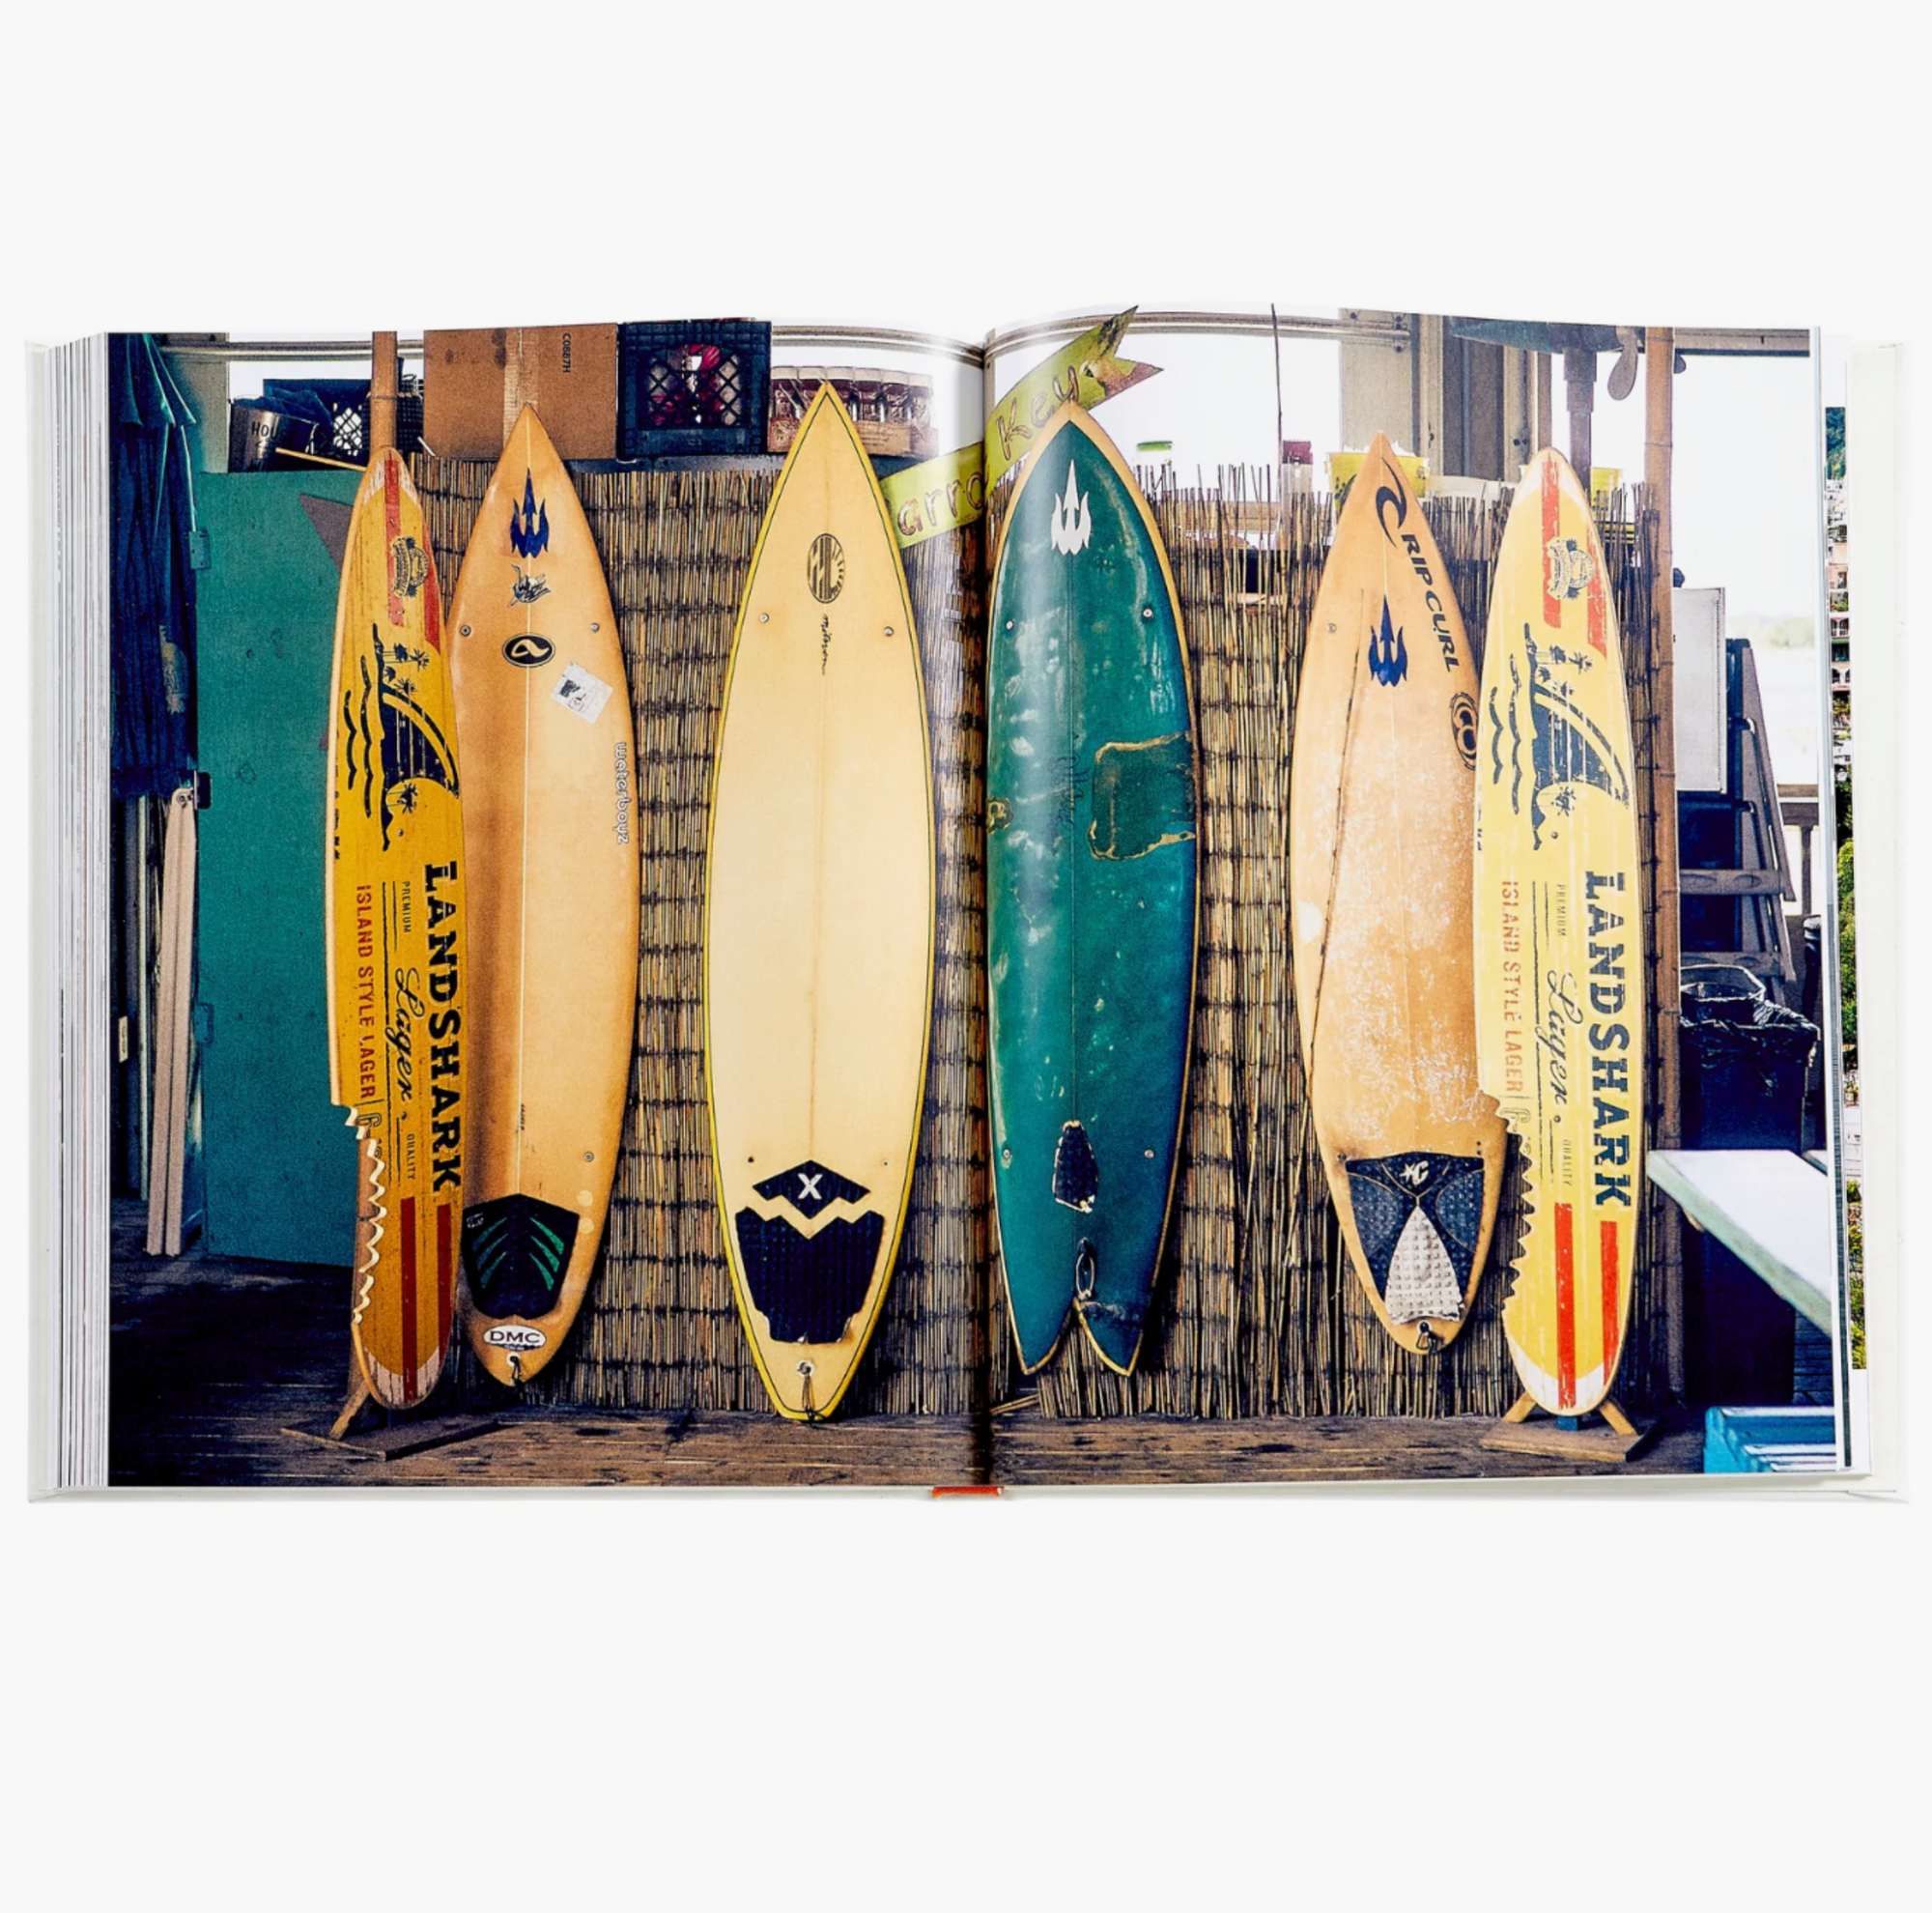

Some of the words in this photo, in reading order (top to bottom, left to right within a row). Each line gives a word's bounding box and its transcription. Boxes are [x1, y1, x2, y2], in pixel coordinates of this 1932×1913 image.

[997, 365, 1080, 462] Key
[1401, 534, 1433, 585] RIP
[1425, 589, 1460, 672] CURL
[612, 741, 632, 844] waterboyz
[356, 884, 373, 958] ISLAND
[402, 881, 412, 933] PREMIUM
[1502, 881, 1520, 953] ISLAND
[1556, 883, 1567, 936] PREMIUM
[358, 965, 375, 1027] STYLE
[1503, 960, 1521, 1021] STYLE
[384, 967, 425, 1101] Lager
[425, 861, 462, 1192] LANDSHARK
[1504, 1029, 1523, 1092] LAGER
[1535, 969, 1583, 1105] Lager
[1585, 871, 1631, 1206] LANDSHARK
[359, 1034, 376, 1099] LAGER
[407, 1133, 416, 1180] QUALITY
[797, 1173, 823, 1199] X
[489, 1330, 541, 1344] DMC
